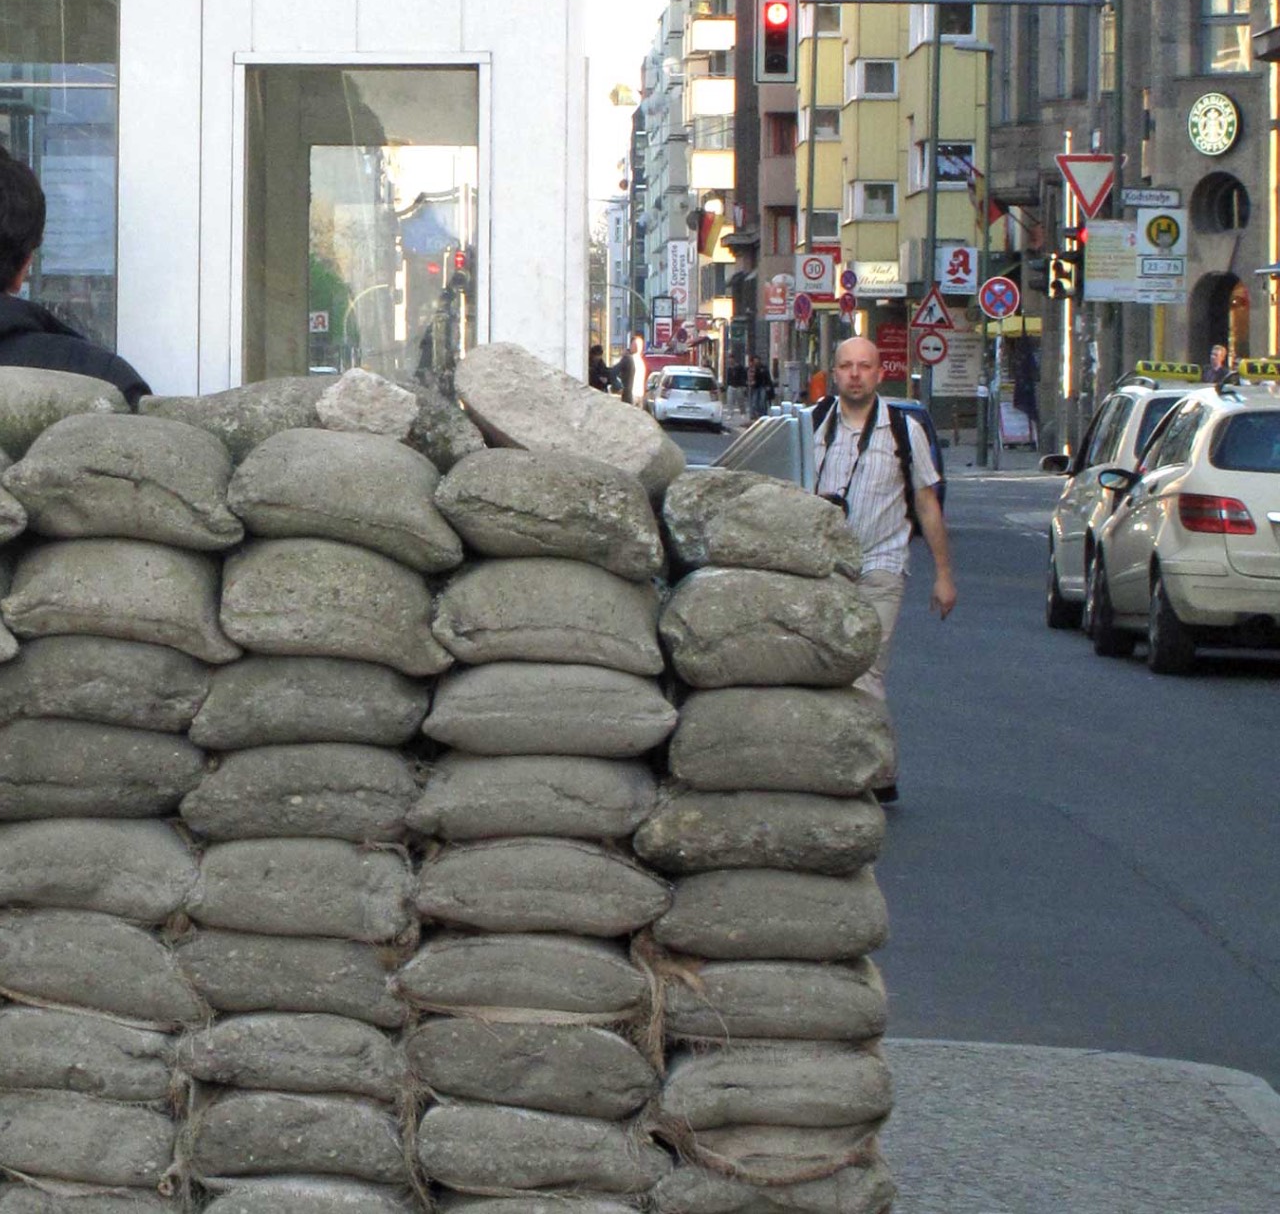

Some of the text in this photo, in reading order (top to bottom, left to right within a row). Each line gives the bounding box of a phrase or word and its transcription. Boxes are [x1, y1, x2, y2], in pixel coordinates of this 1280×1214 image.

[1195, 135, 1230, 152] COFFEE
[670, 244, 679, 286] Corporate
[678, 254, 687, 286] Express
[807, 263, 821, 275] 30
[1150, 364, 1192, 374] TAXI
